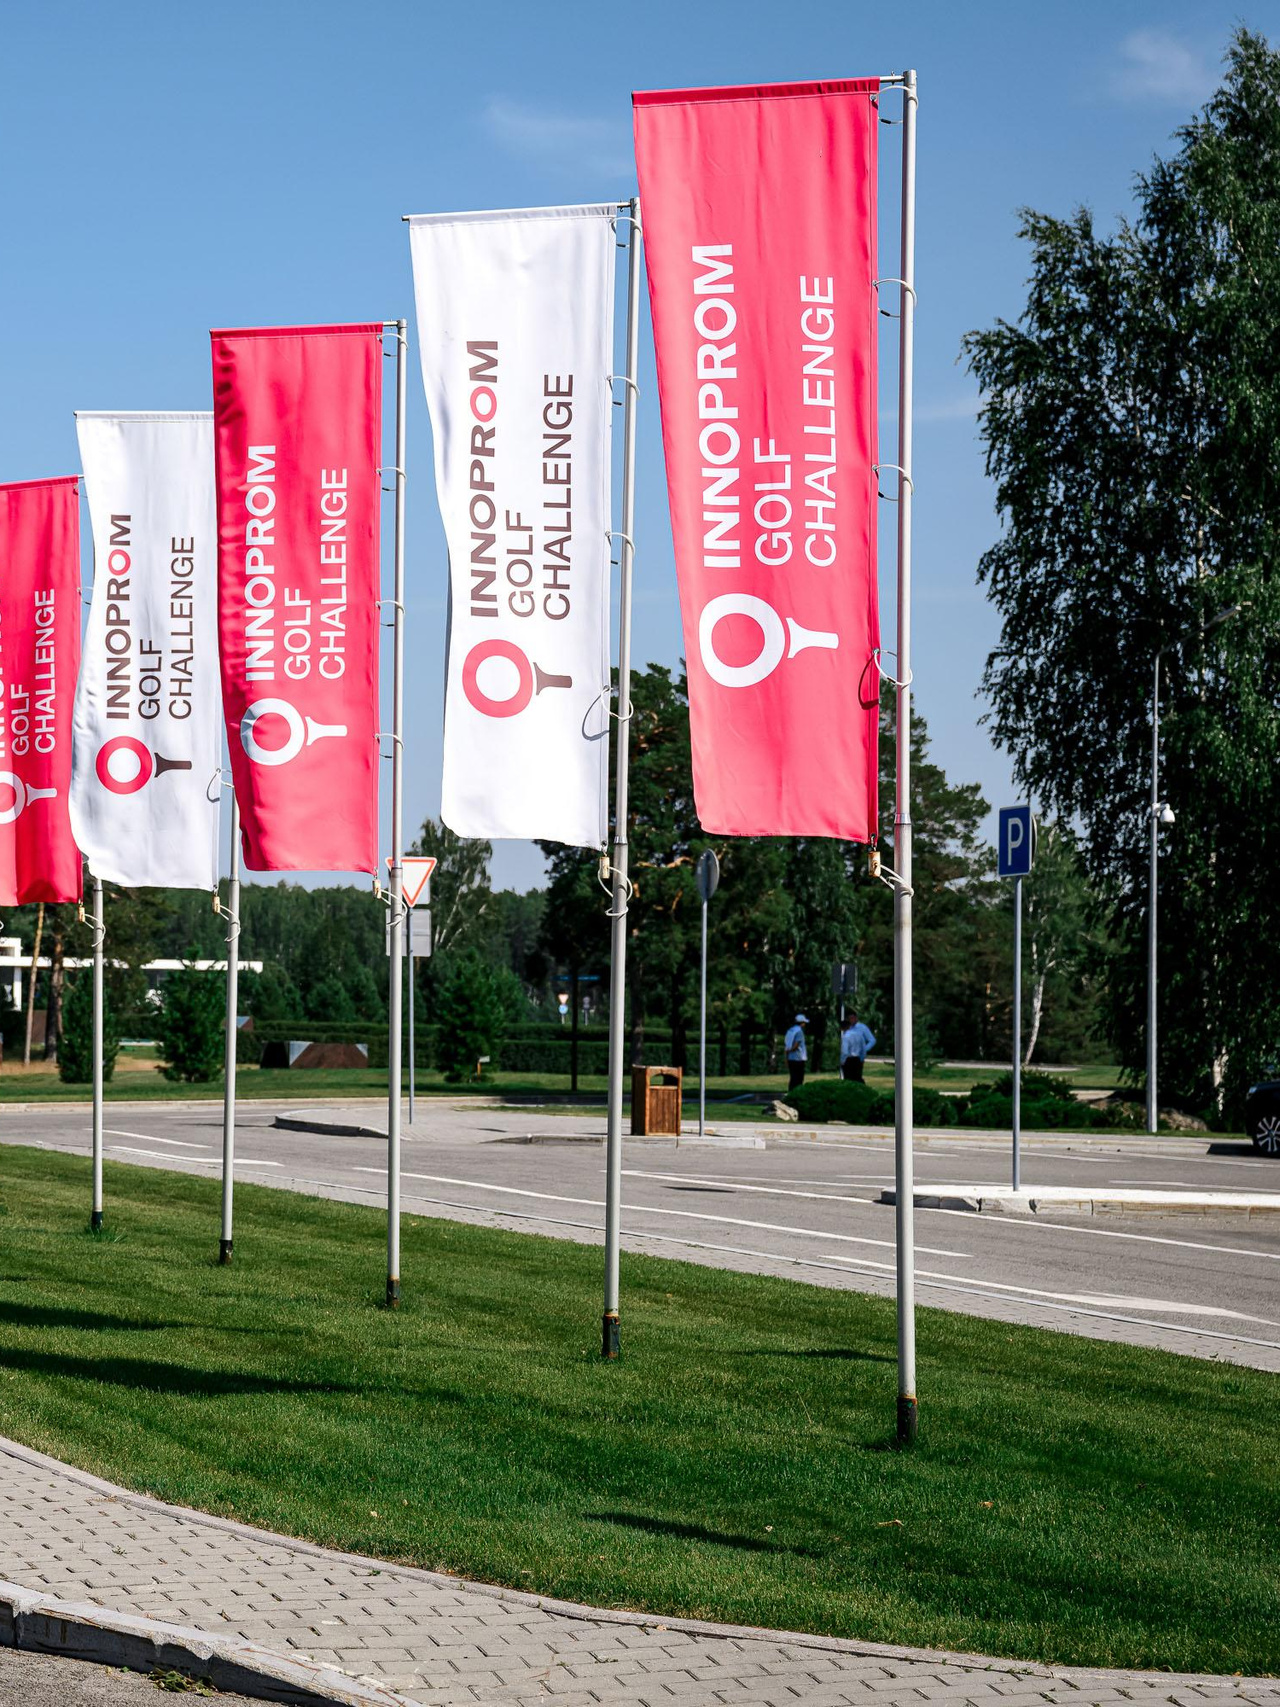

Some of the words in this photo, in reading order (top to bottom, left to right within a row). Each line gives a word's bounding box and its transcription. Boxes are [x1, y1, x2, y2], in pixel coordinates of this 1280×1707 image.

[466, 340, 499, 618] INNOPROM
[543, 374, 574, 620] CHALLENGE
[692, 243, 742, 568] INNOPROM
[800, 275, 838, 568] CHALLENGE
[244, 445, 277, 681] INNOPROM
[319, 468, 348, 680] CHALLENGE
[506, 509, 535, 618] GOLF
[754, 437, 792, 566] GOLF
[34, 588, 55, 754] CHALLENGE
[106, 514, 132, 720] INNOPROM
[138, 639, 162, 720] GOLF
[169, 536, 195, 720] CHALLENGE
[284, 588, 312, 681] GOLF
[11, 684, 30, 756] GOLF
[1007, 817, 1023, 866] P
